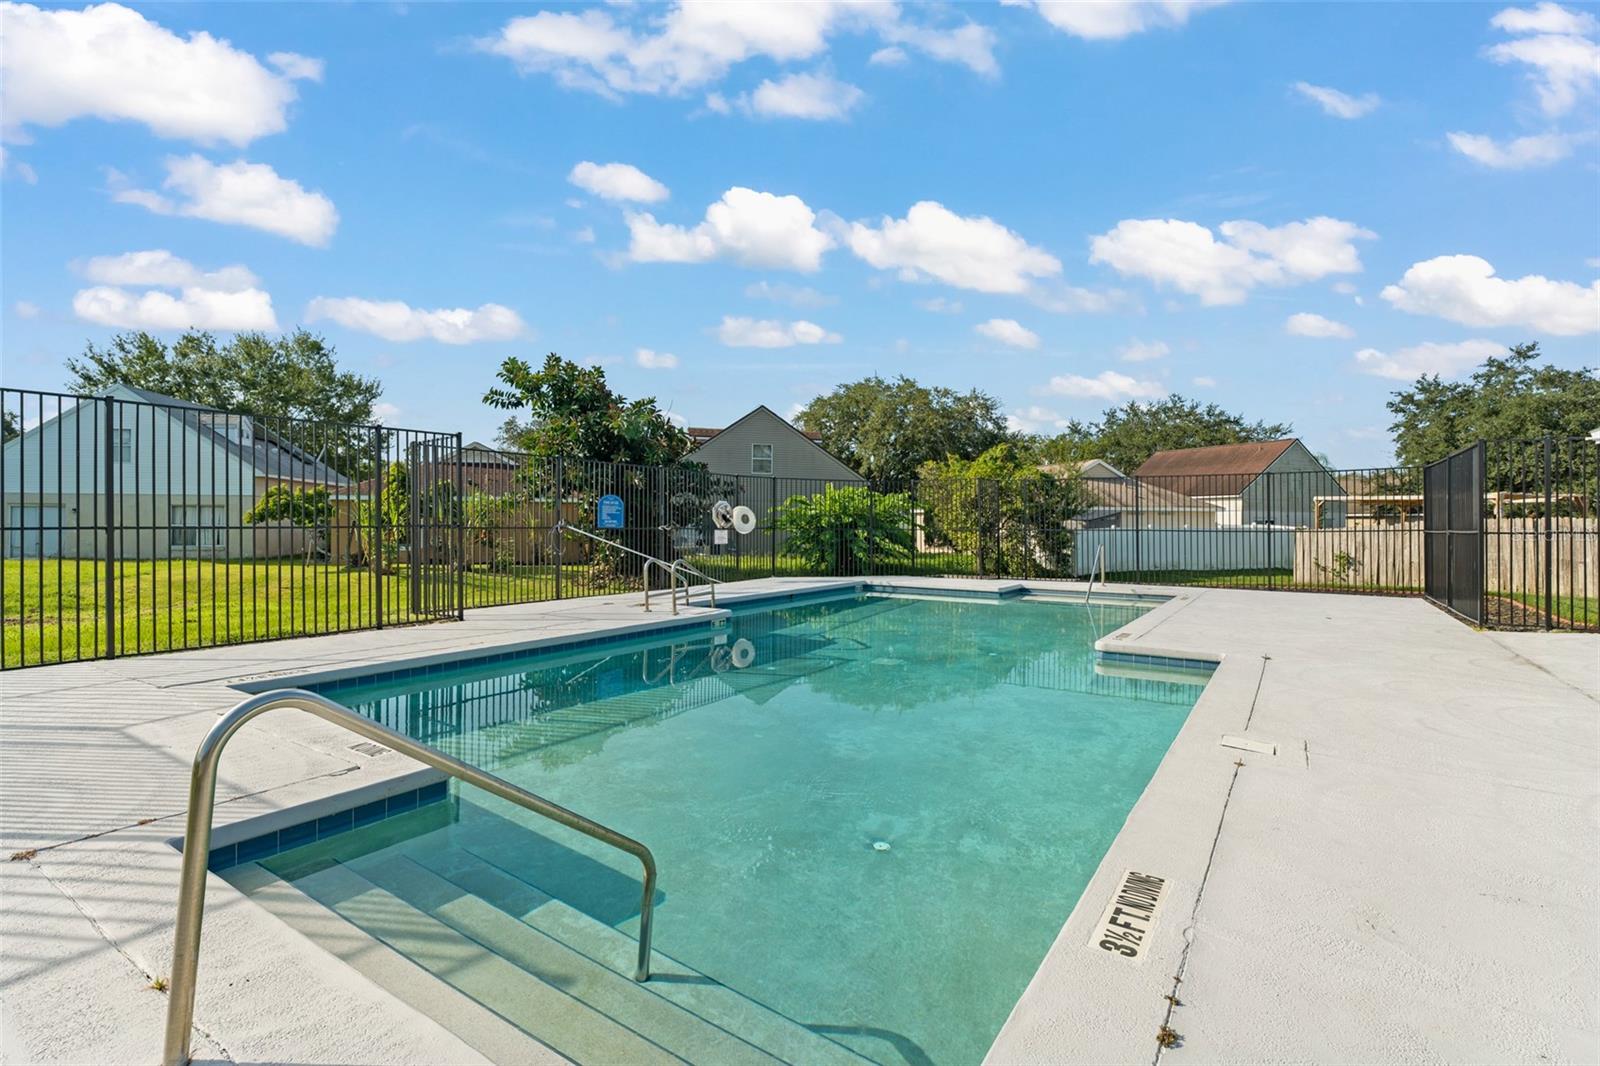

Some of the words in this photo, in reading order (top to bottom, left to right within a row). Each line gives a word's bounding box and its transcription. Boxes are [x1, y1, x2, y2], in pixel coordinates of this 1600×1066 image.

[1121, 871, 1165, 901] DIVING
[1116, 895, 1155, 913] NO
[1108, 906, 1151, 934] FT.
